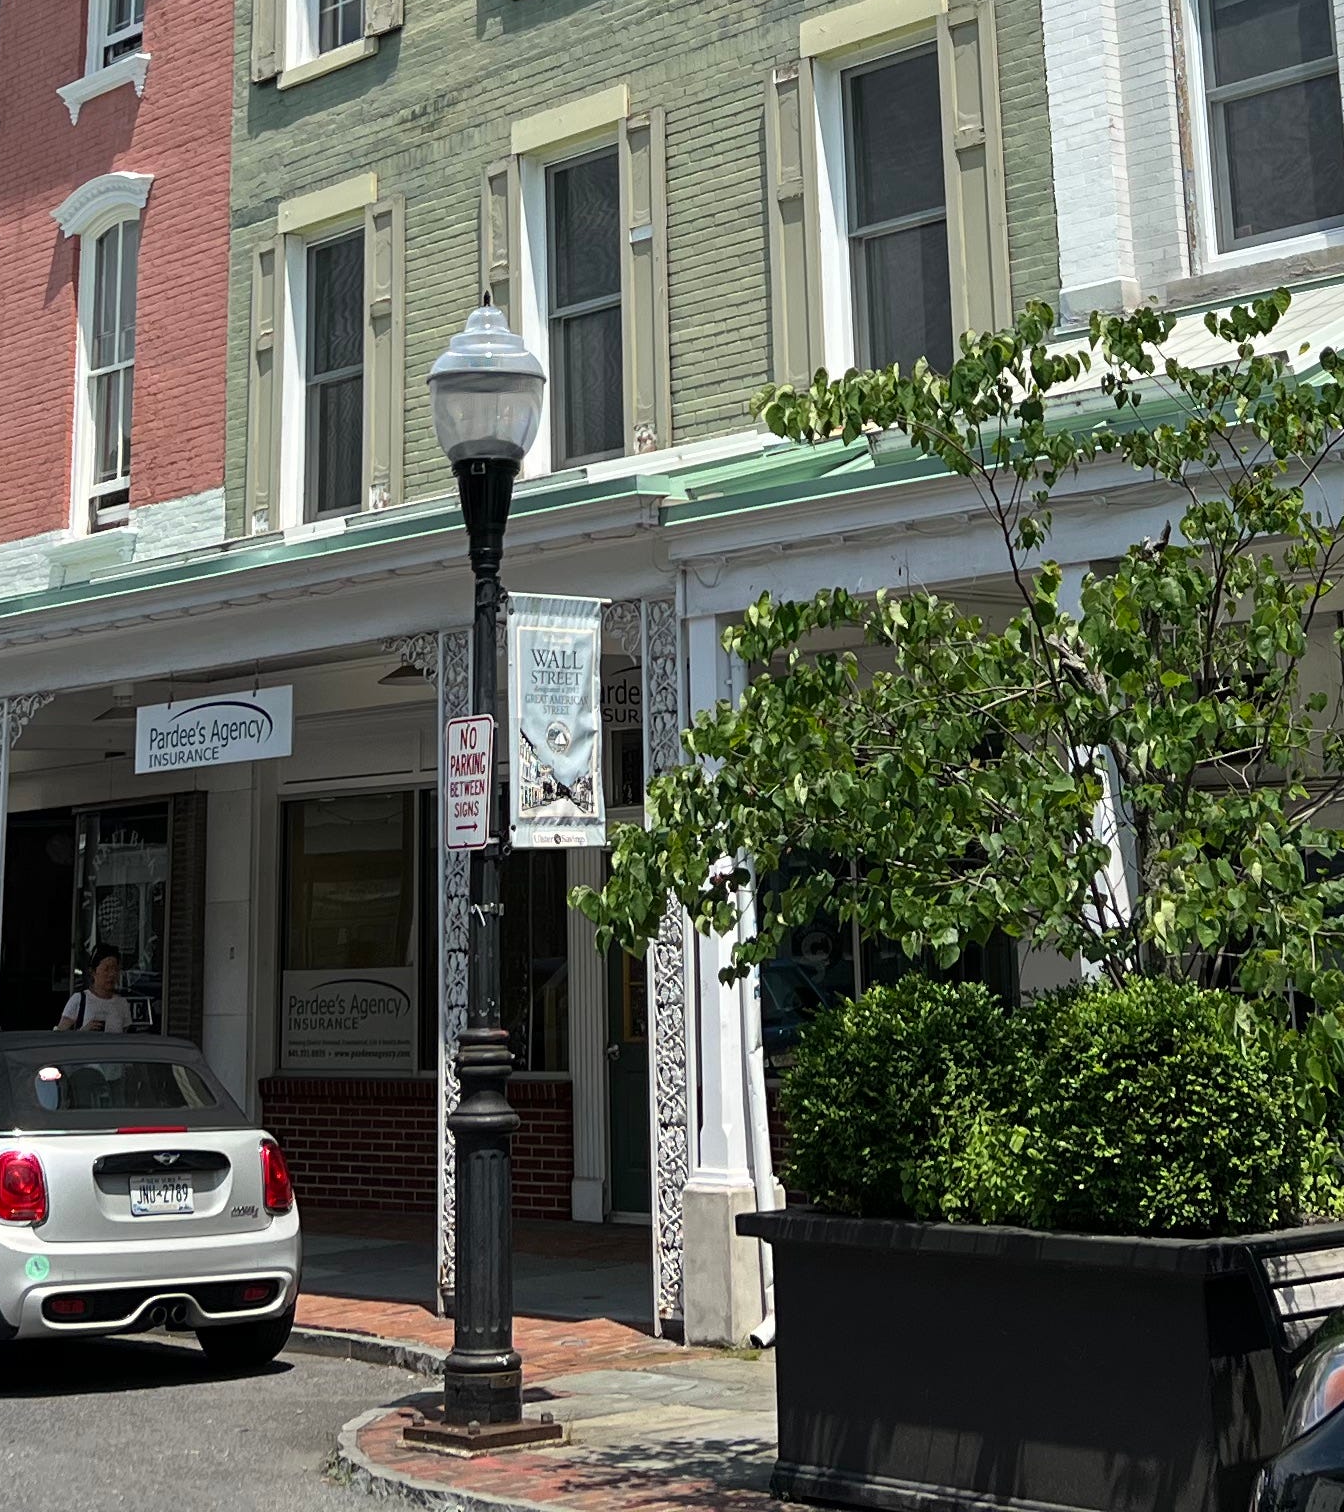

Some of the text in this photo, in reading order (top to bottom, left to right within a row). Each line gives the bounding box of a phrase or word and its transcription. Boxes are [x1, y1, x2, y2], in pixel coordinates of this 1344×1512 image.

[530, 648, 584, 670] WALL
[531, 670, 582, 686] STREET
[525, 694, 548, 704] GREAT
[543, 705, 570, 715] STREET
[149, 718, 265, 751] Pardee's Agency
[460, 726, 477, 750] NO
[148, 746, 219, 768] INSURANCE
[450, 752, 485, 778] PARKING
[449, 779, 485, 798] BETWEEN
[454, 801, 479, 819] SIGNS
[288, 992, 403, 1020] Pardee's Agency
[287, 1016, 359, 1031] INSURANCE
